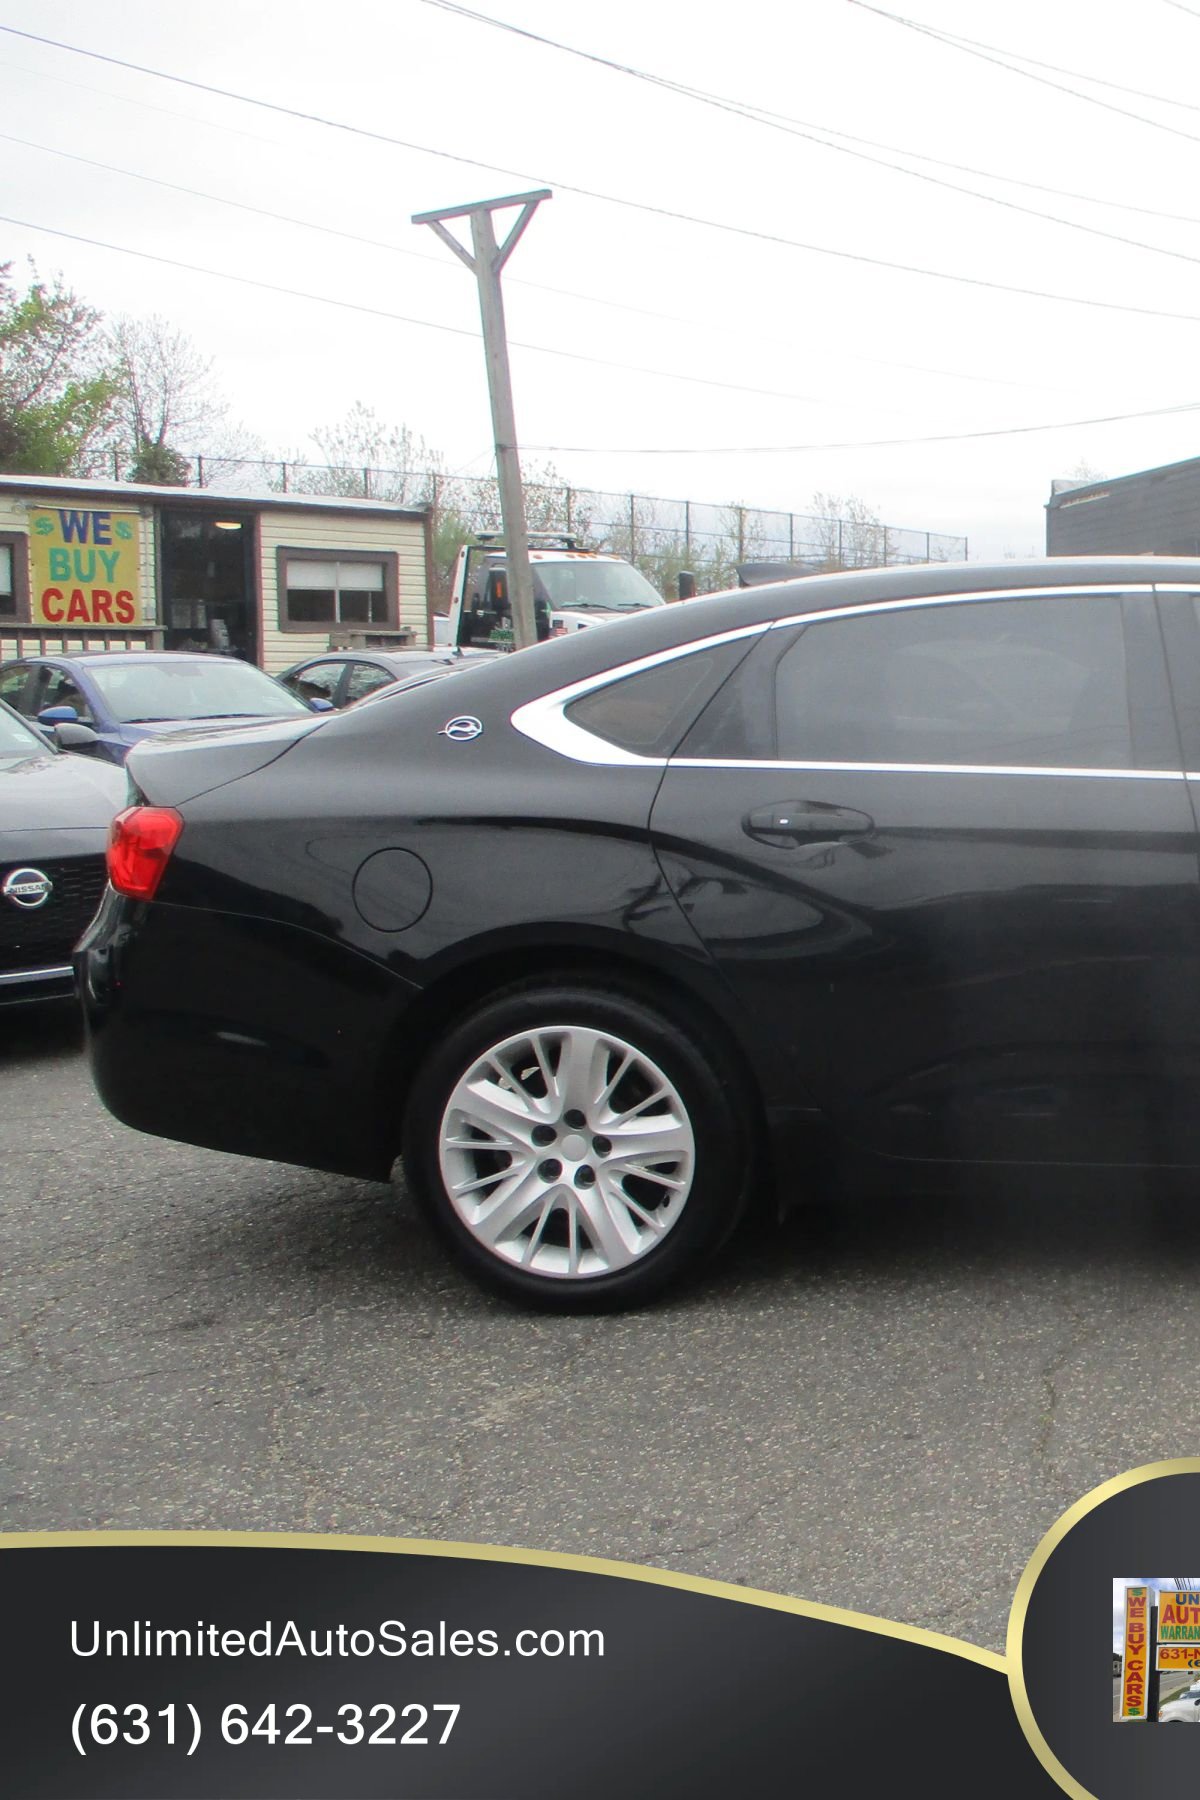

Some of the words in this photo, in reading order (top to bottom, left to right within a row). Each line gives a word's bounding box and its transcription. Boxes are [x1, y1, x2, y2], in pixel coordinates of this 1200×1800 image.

[57, 508, 113, 546] WE
[48, 547, 121, 584] BUY
[41, 587, 136, 624] CARS
